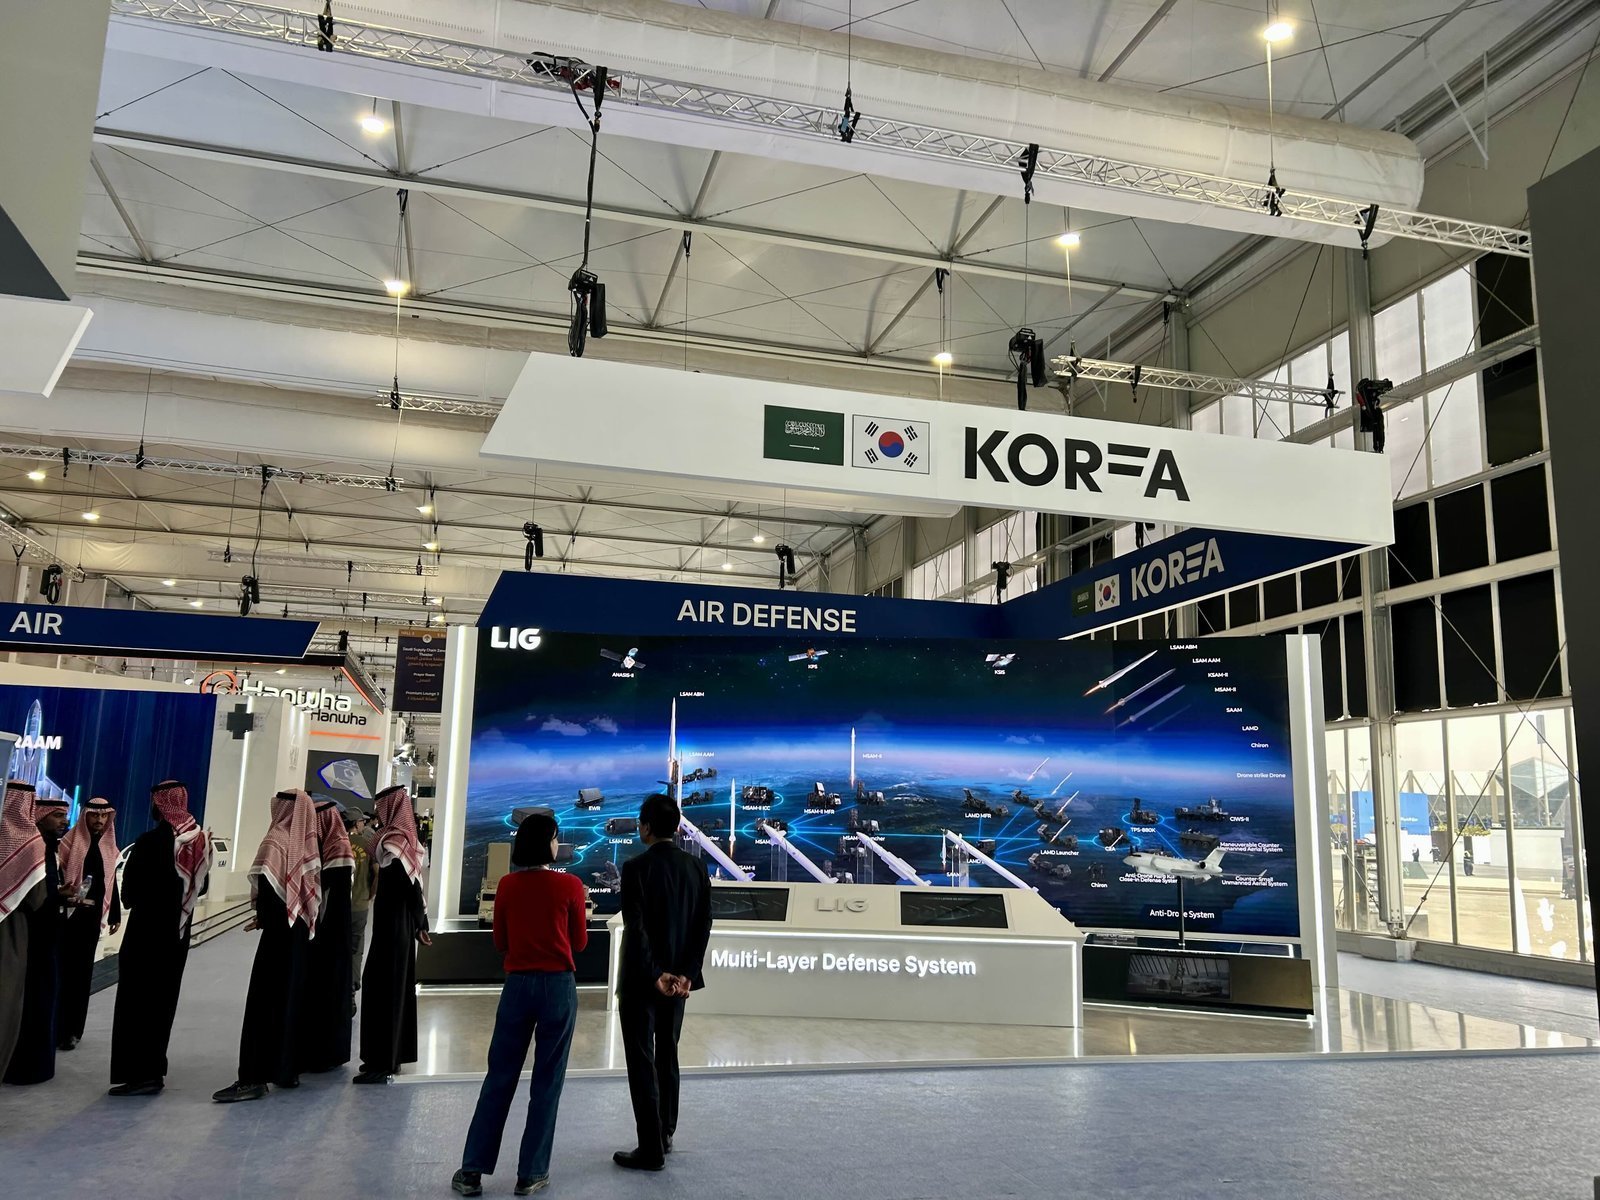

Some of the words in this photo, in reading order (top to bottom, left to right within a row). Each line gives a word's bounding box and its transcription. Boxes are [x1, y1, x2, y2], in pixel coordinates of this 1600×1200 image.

[964, 426, 1191, 502] KOREA
[1130, 536, 1225, 602] KOREA
[9, 611, 63, 636] AIR
[676, 599, 725, 624] AIR
[732, 602, 857, 633] DEFENSE
[490, 626, 542, 650] LIG
[311, 710, 367, 726] Hanwha
[815, 896, 870, 913] LIG
[1149, 909, 1188, 918] Anti-Droe
[1188, 910, 1215, 919] System
[710, 949, 819, 974] Multi-Layer
[822, 952, 901, 973] Defense
[904, 955, 977, 978] System
